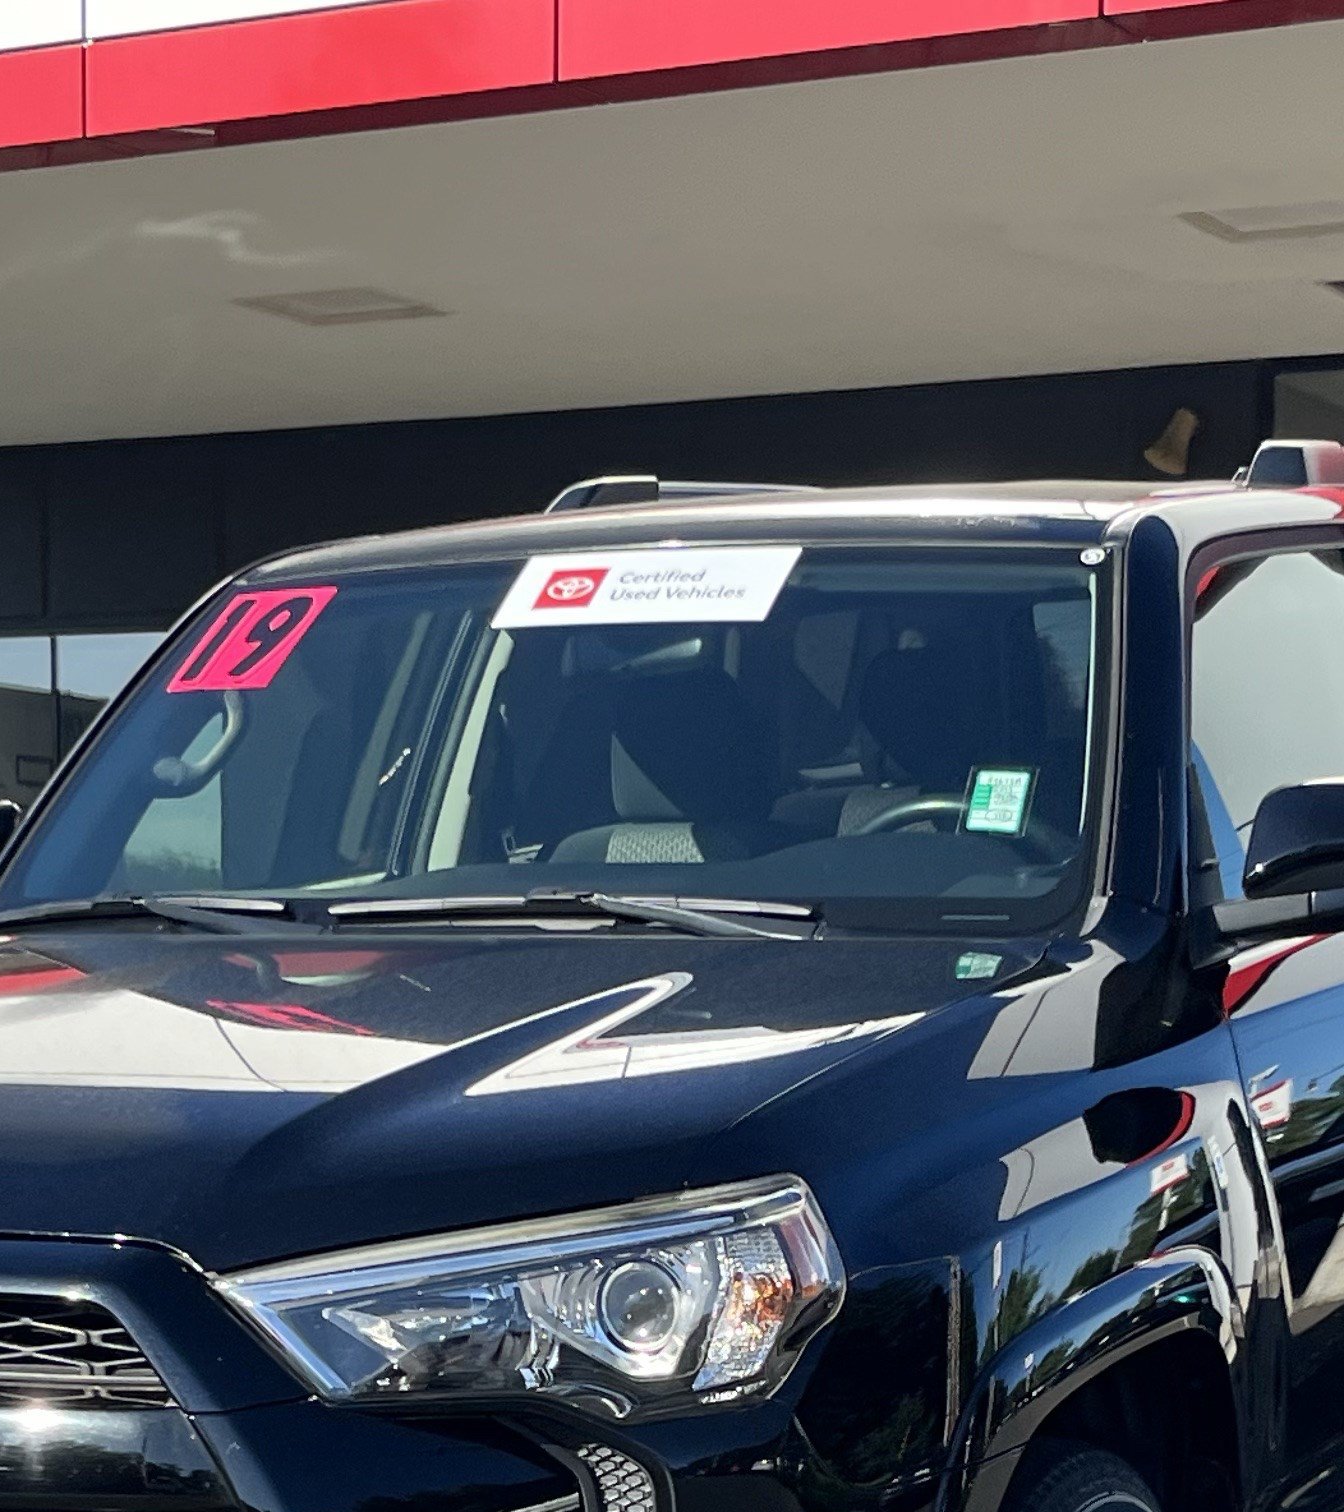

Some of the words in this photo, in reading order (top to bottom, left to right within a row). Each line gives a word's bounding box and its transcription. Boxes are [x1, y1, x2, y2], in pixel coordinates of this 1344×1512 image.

[619, 568, 706, 585] Certified
[610, 588, 661, 602] Used
[666, 585, 746, 601] Vehicles
[180, 595, 314, 681] 19
